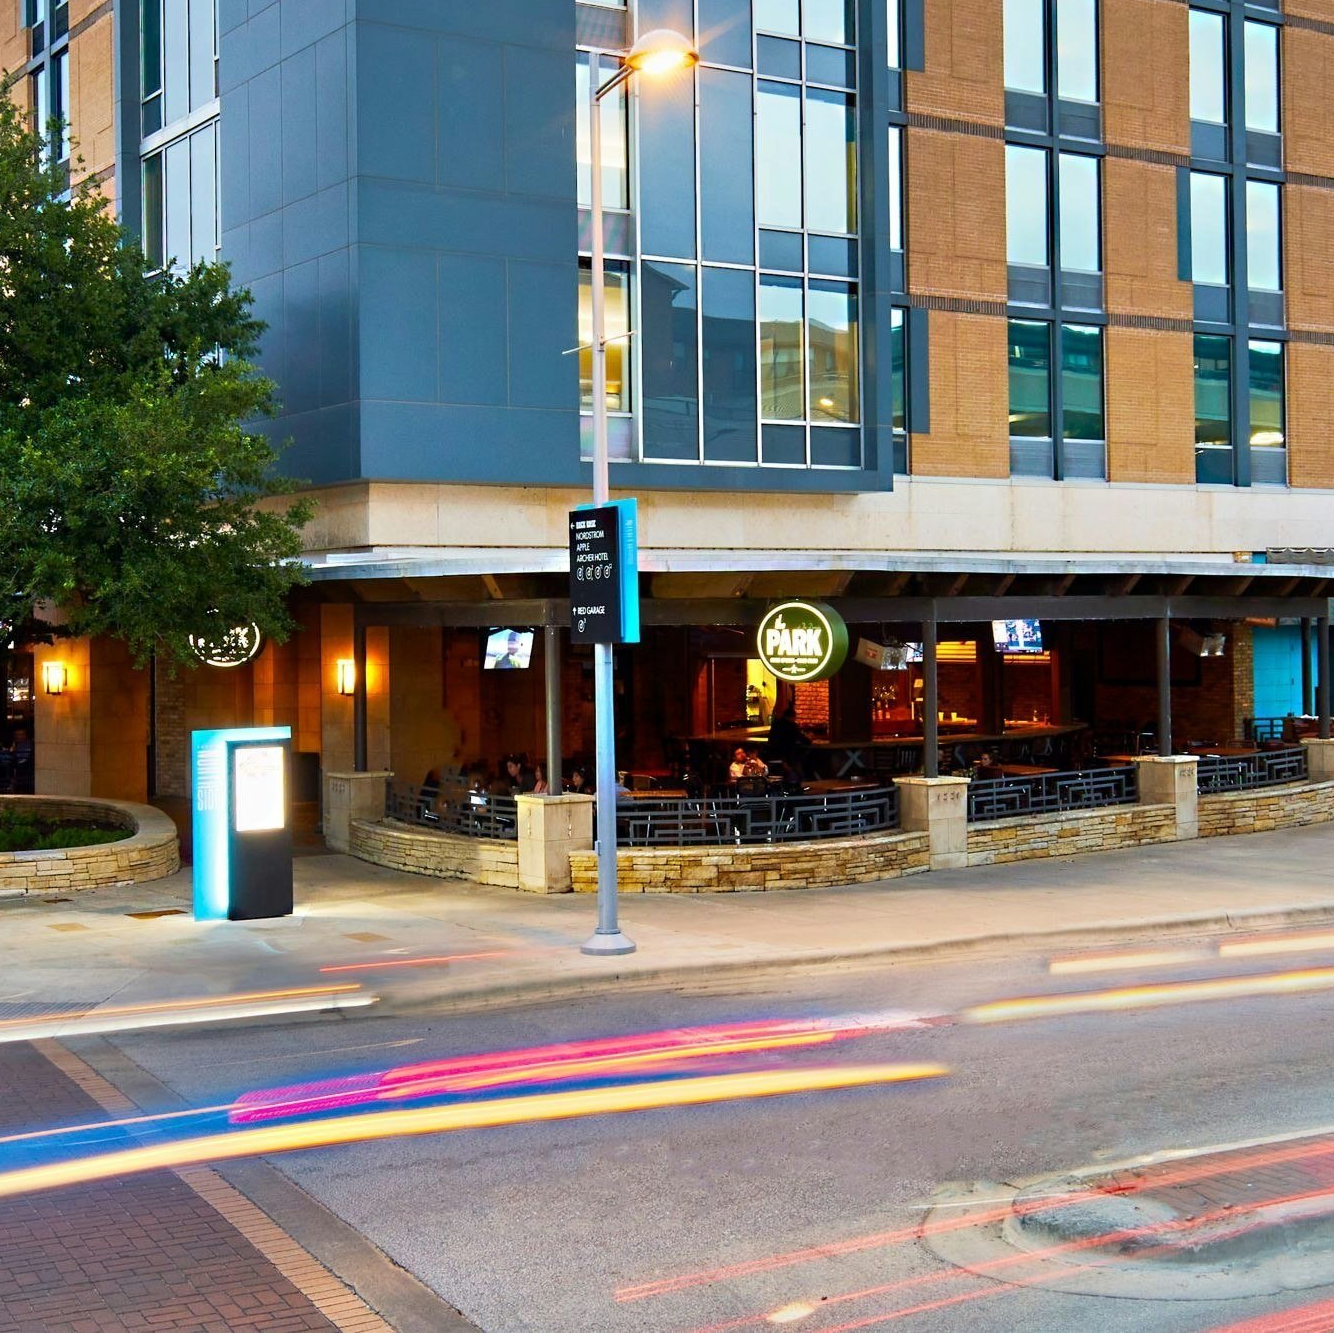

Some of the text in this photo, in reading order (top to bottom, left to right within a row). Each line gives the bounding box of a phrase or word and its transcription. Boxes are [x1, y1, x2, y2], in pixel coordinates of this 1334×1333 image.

[576, 530, 605, 540] NORDSTROM
[577, 543, 590, 551] APPLE
[577, 552, 609, 562] ARCHER HOTEL
[578, 605, 605, 615] RED GARAGE
[766, 628, 823, 657] PARK
